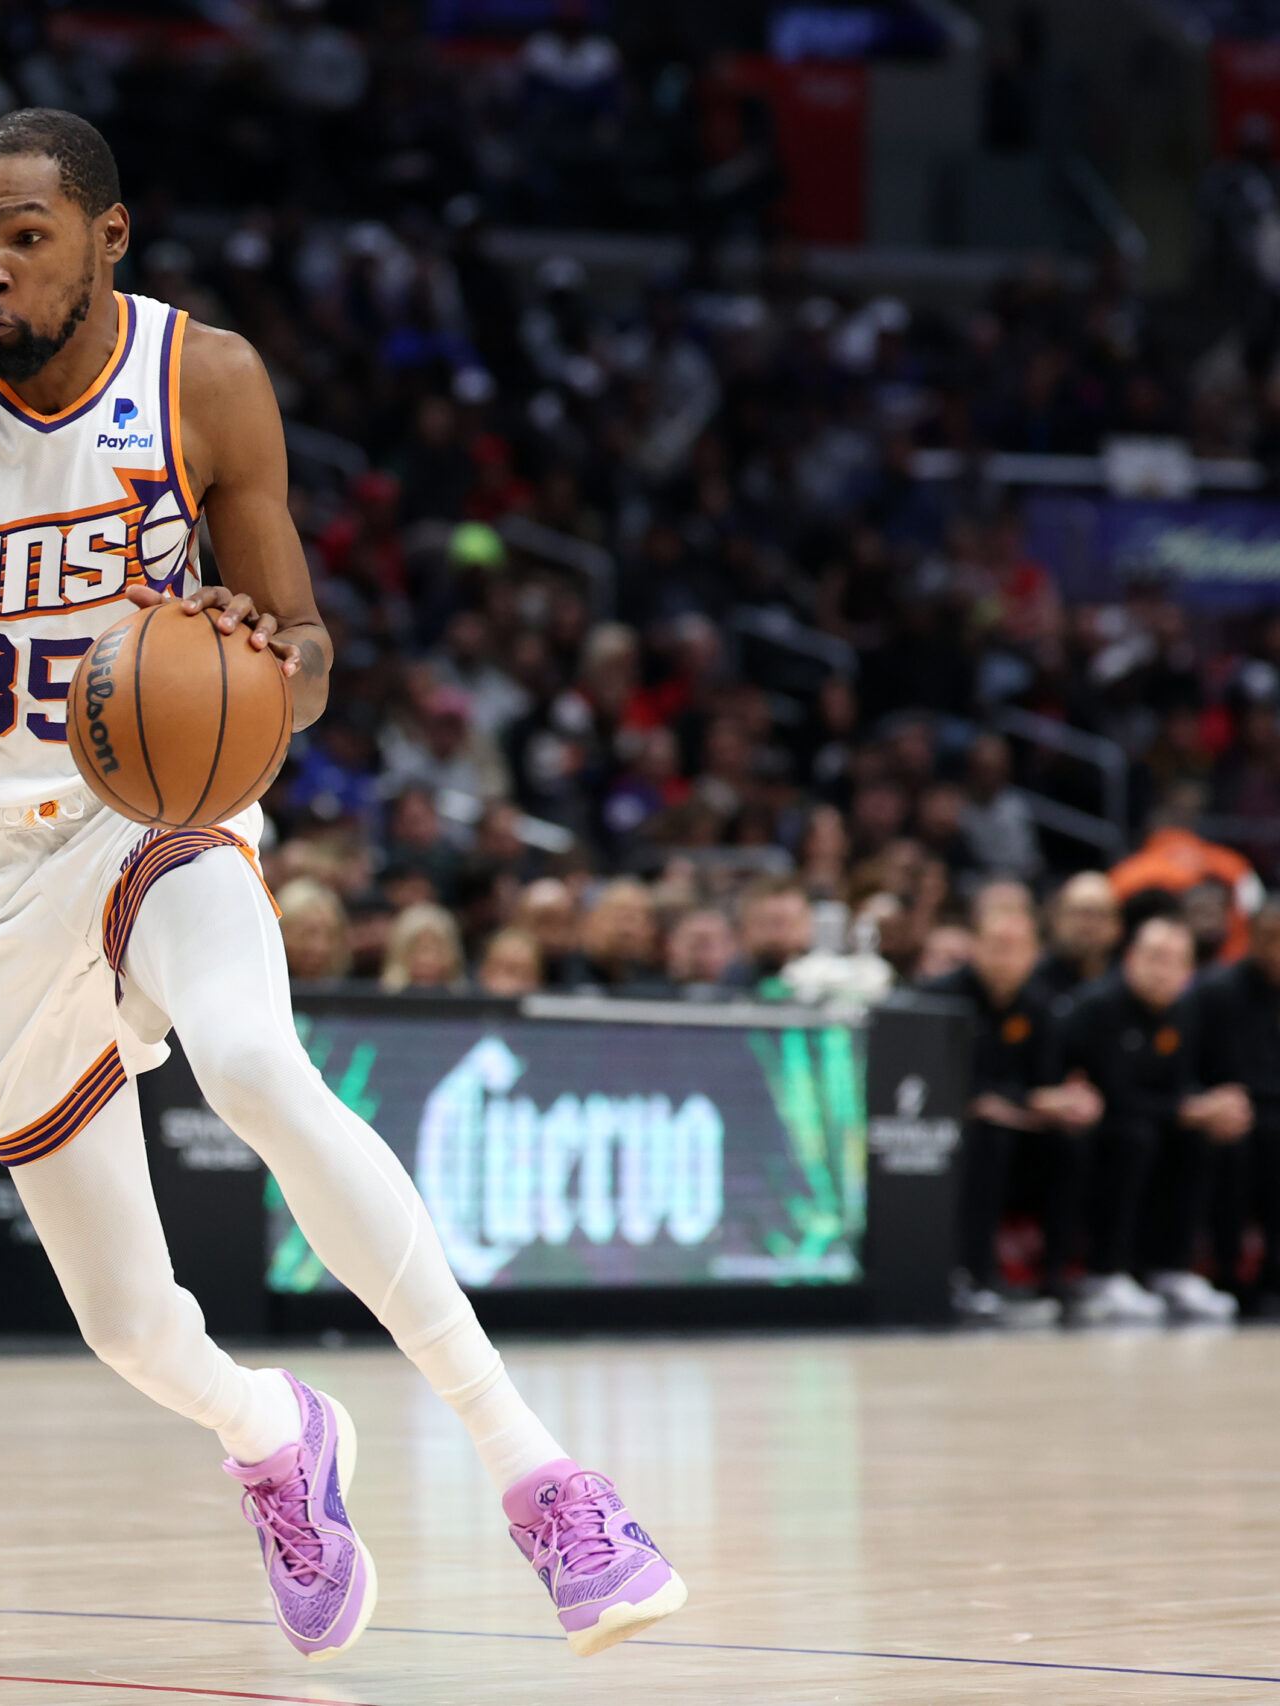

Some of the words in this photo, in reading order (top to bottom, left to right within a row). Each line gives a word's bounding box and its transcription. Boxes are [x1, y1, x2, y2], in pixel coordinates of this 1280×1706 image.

[96, 433, 154, 451] PayPal
[86, 624, 132, 776] Wilson
[415, 1036, 725, 1287] Cuervo
